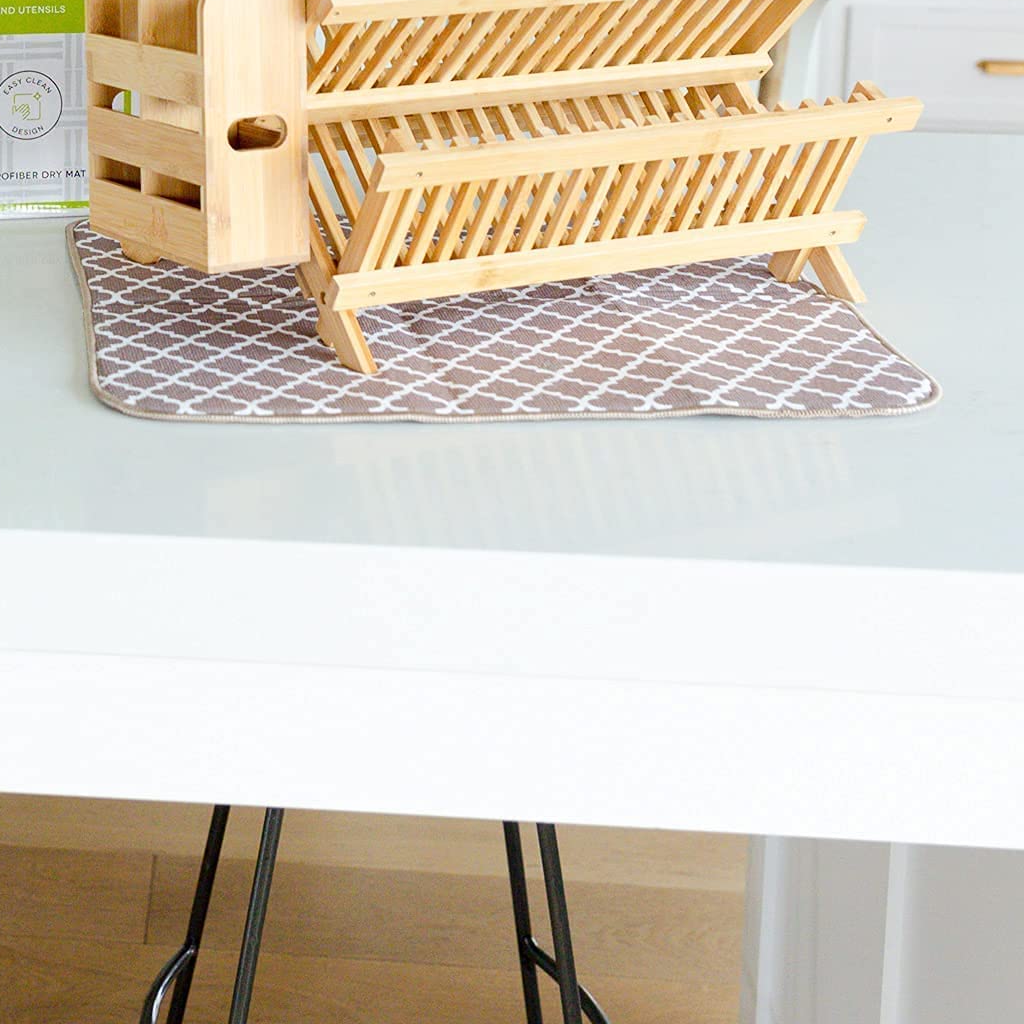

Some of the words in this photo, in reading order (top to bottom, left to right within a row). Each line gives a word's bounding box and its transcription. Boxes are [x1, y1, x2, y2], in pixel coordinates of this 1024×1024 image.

[18, 5, 66, 15] UTENSILS
[3, 78, 23, 96] EASY
[26, 77, 52, 94] CLEAN
[12, 125, 44, 136] DESIGN
[41, 170, 63, 179] DRY
[65, 169, 86, 178] MAT
